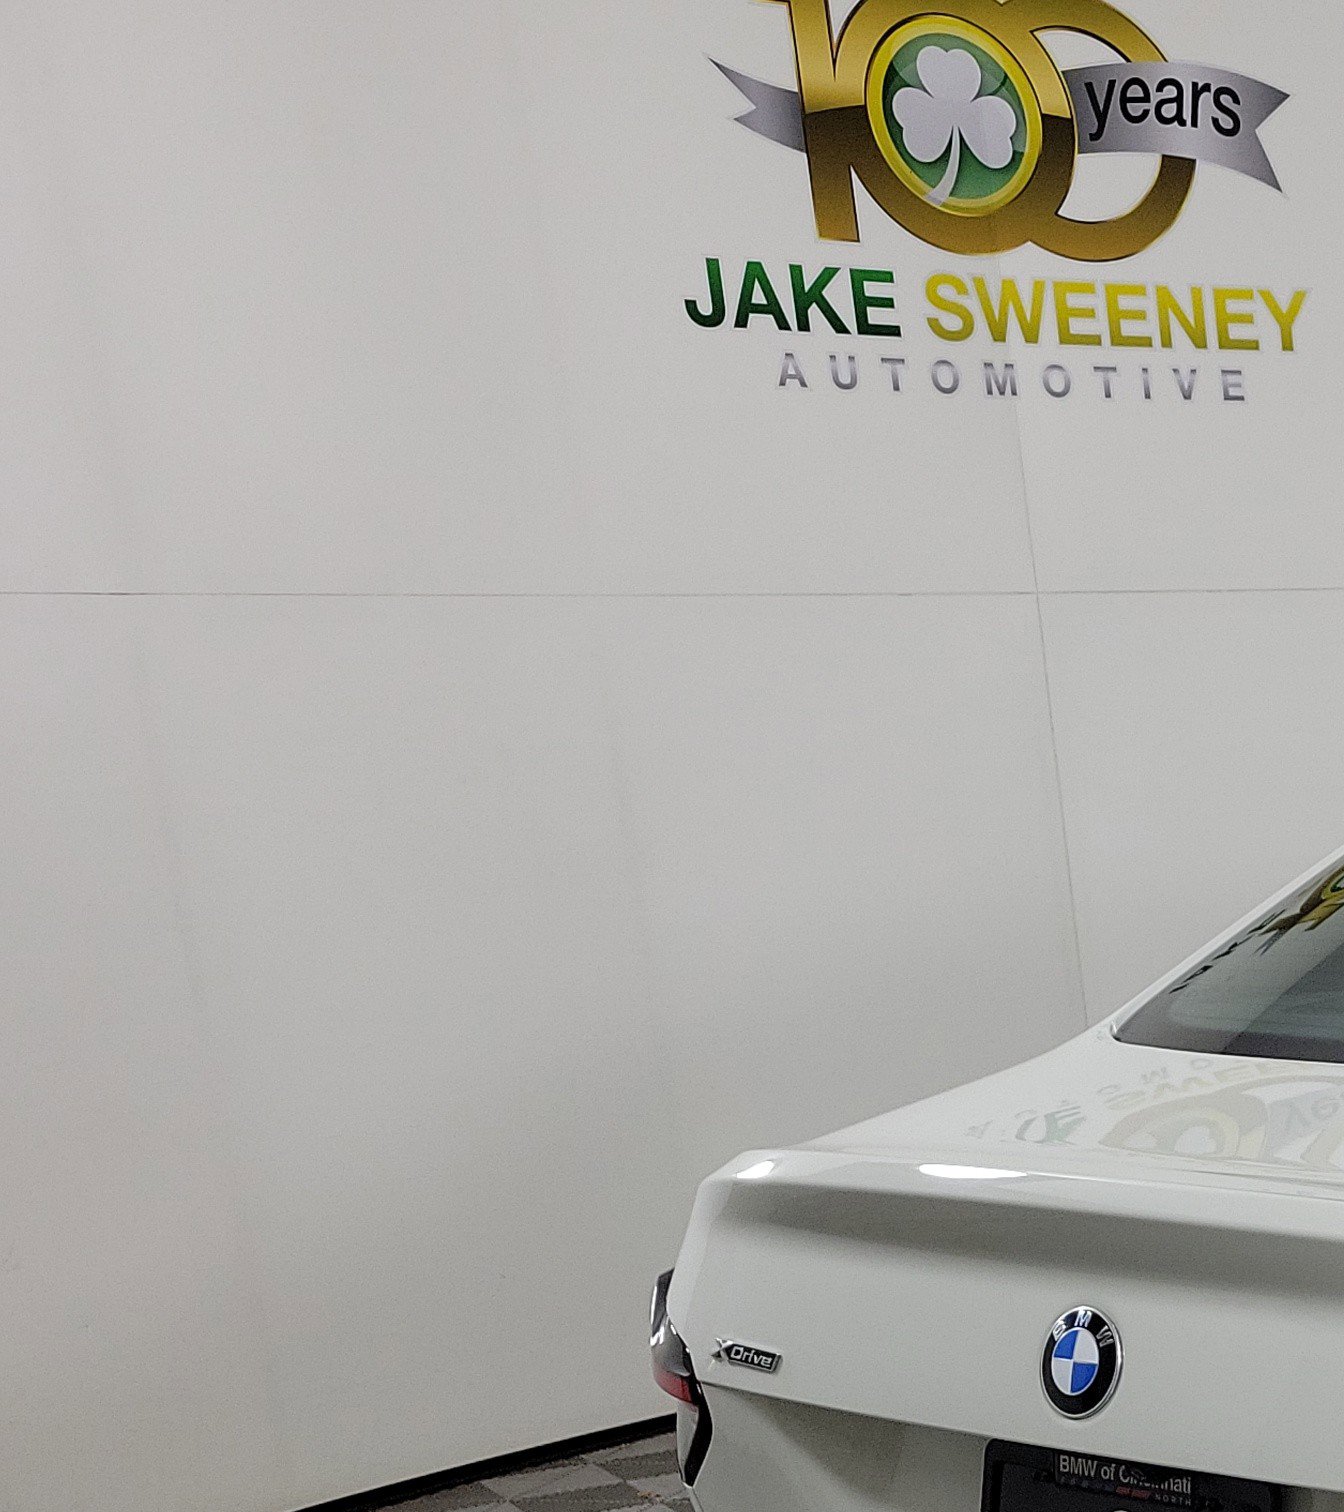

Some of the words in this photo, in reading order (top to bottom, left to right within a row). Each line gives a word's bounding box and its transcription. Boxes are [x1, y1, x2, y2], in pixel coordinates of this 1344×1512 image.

[1083, 75, 1243, 143] years
[684, 256, 902, 338] JAKE
[925, 272, 1309, 352] SWEENEY
[777, 352, 1247, 403] AUTOMOTIVE
[1052, 1309, 1116, 1348] BMW
[1059, 1454, 1098, 1478] BMW
[1100, 1463, 1117, 1481] of
